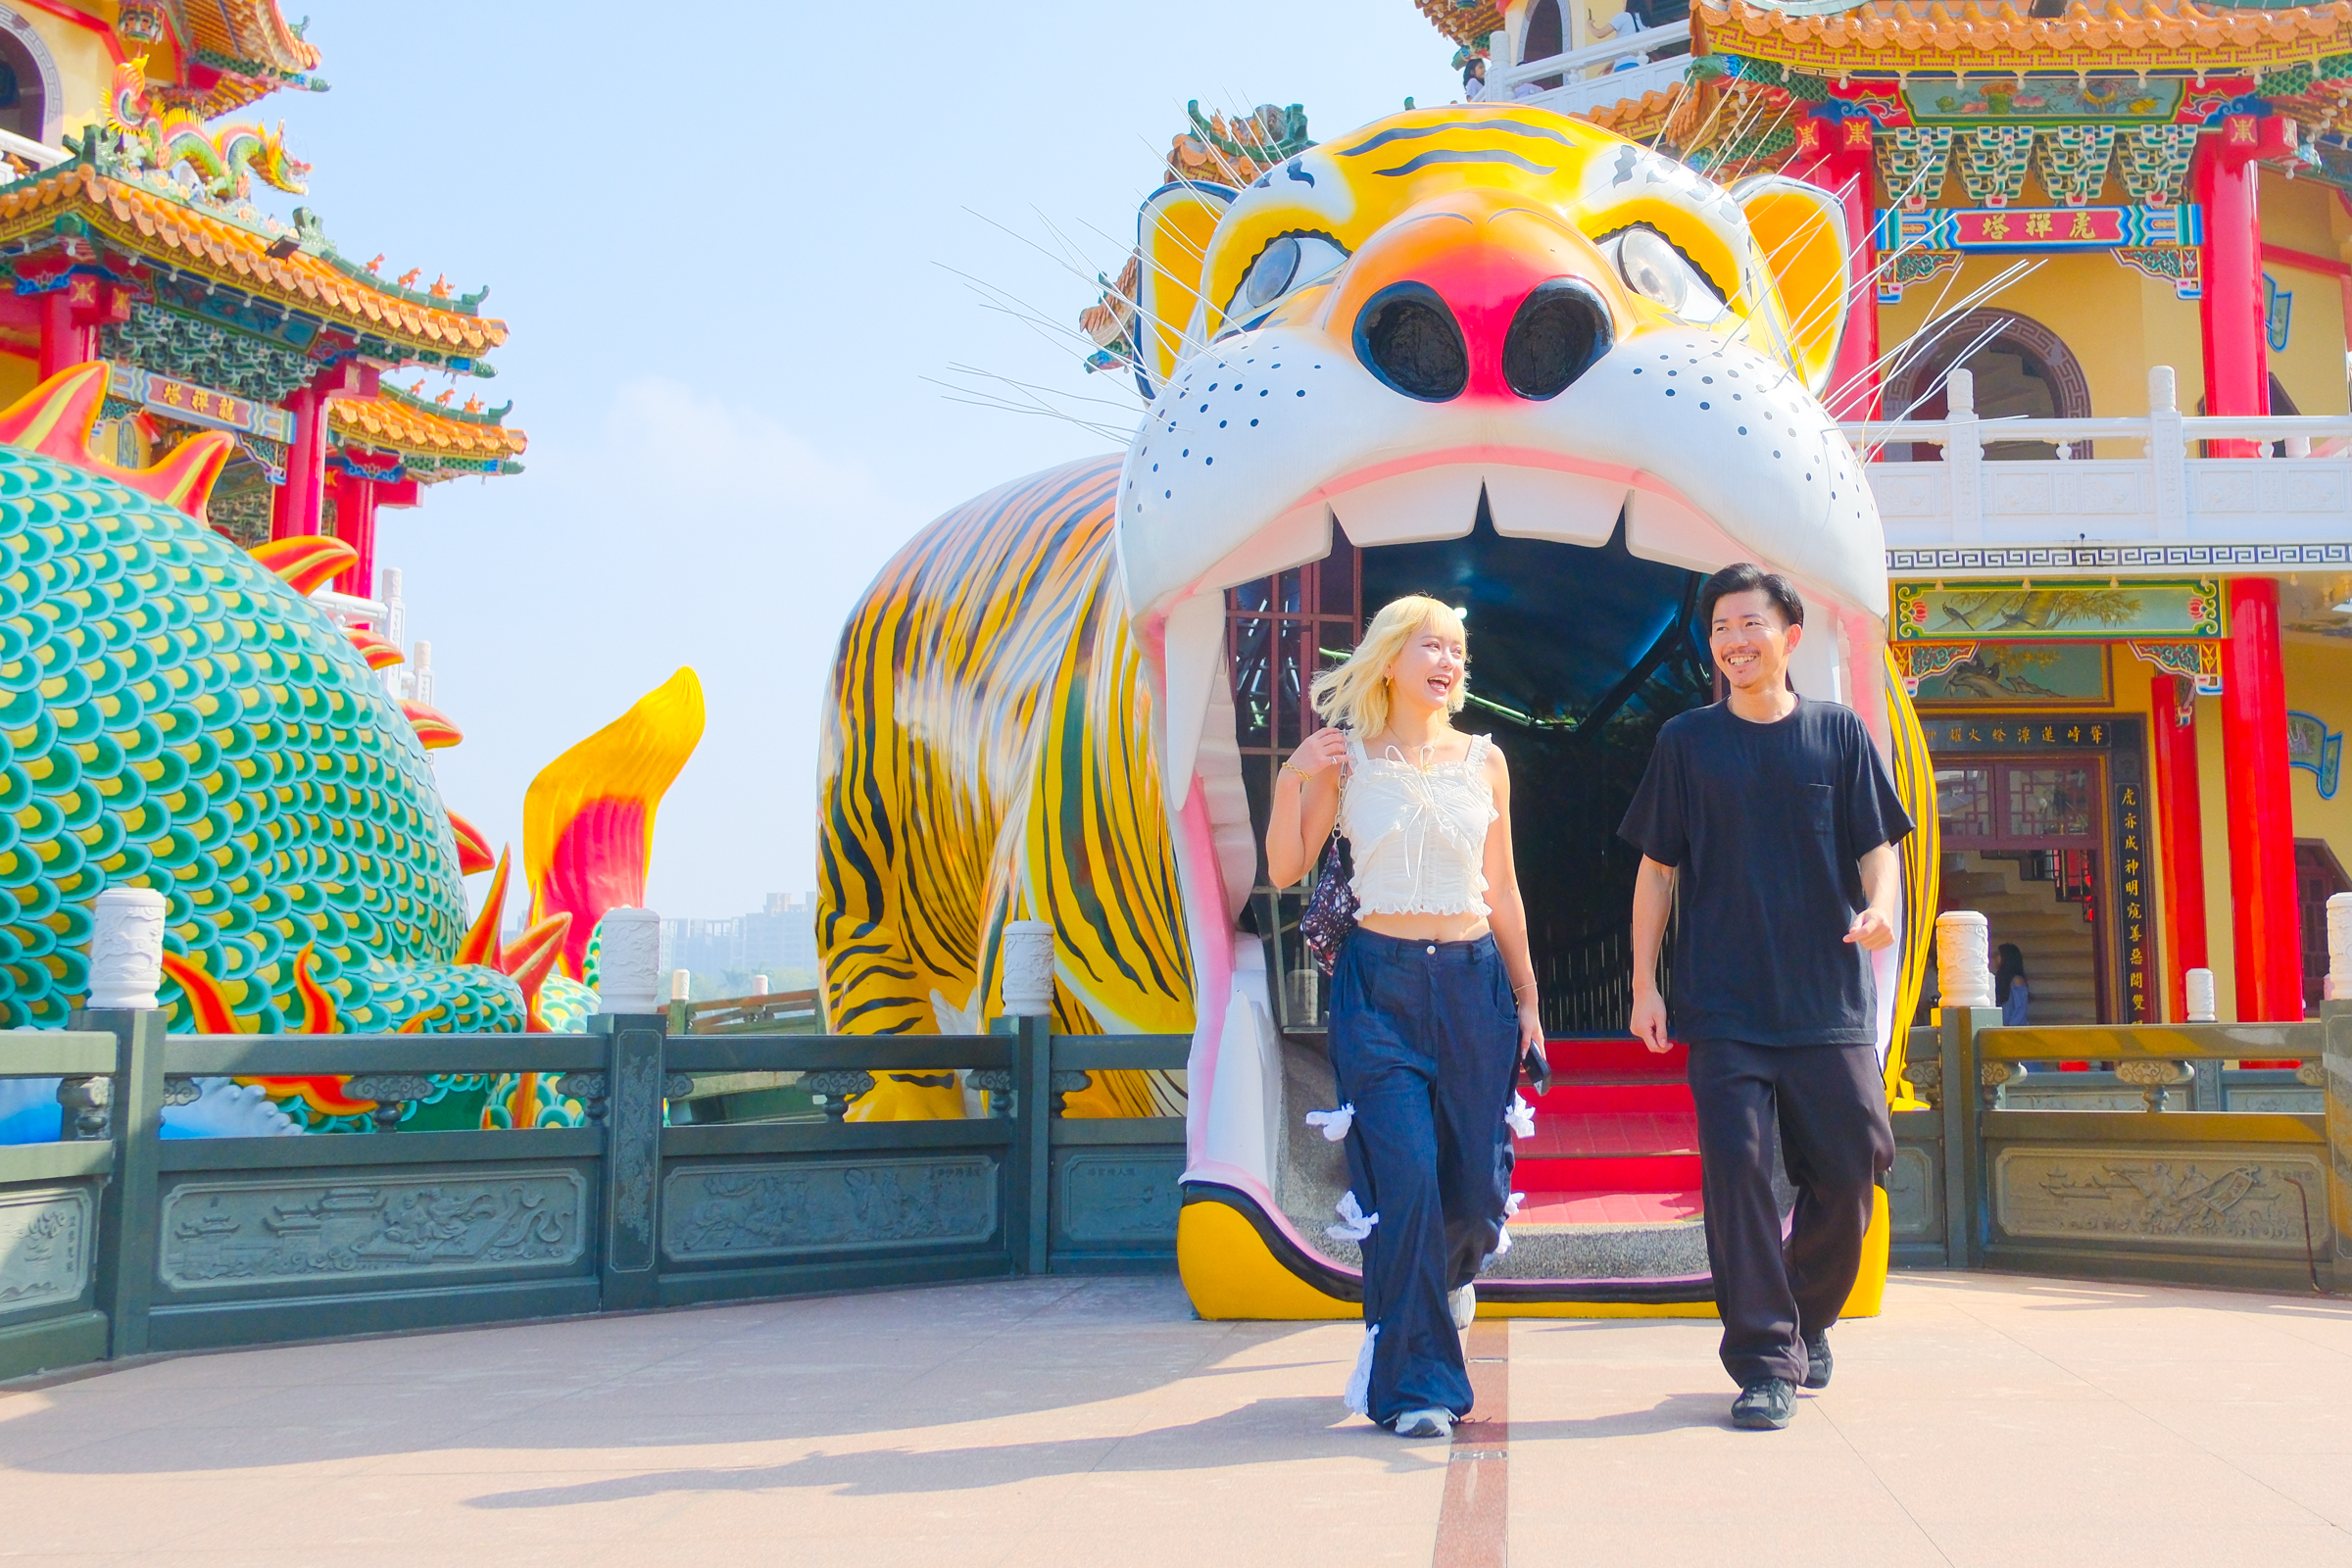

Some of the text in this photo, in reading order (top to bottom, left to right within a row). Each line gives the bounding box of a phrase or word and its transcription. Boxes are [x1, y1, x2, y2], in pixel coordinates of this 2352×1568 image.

[1982, 211, 2096, 240] 虎禪塔
[163, 382, 235, 422] 龍禪塔
